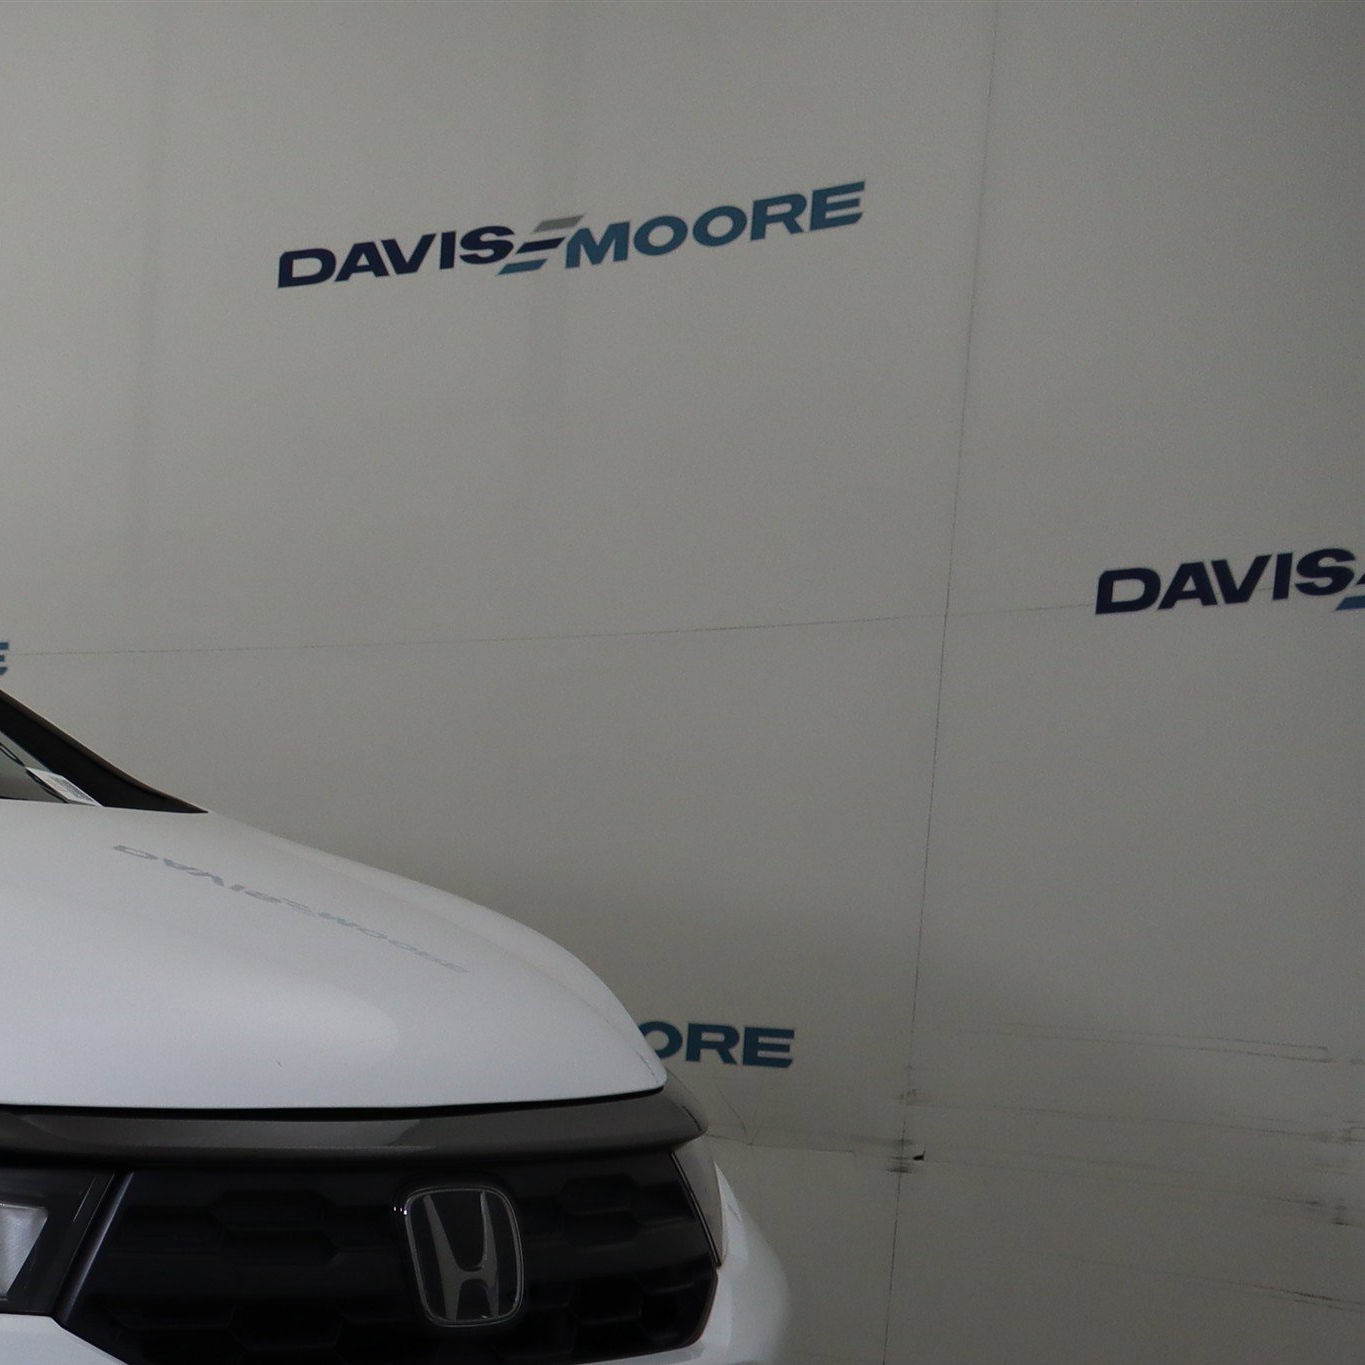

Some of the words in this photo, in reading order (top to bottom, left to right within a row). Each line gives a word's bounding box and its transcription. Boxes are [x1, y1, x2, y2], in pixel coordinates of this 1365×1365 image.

[277, 225, 515, 288] DAVIS
[565, 180, 866, 270] MOORE
[1095, 547, 1357, 615] DAVIS
[637, 1020, 796, 1069] ORE
